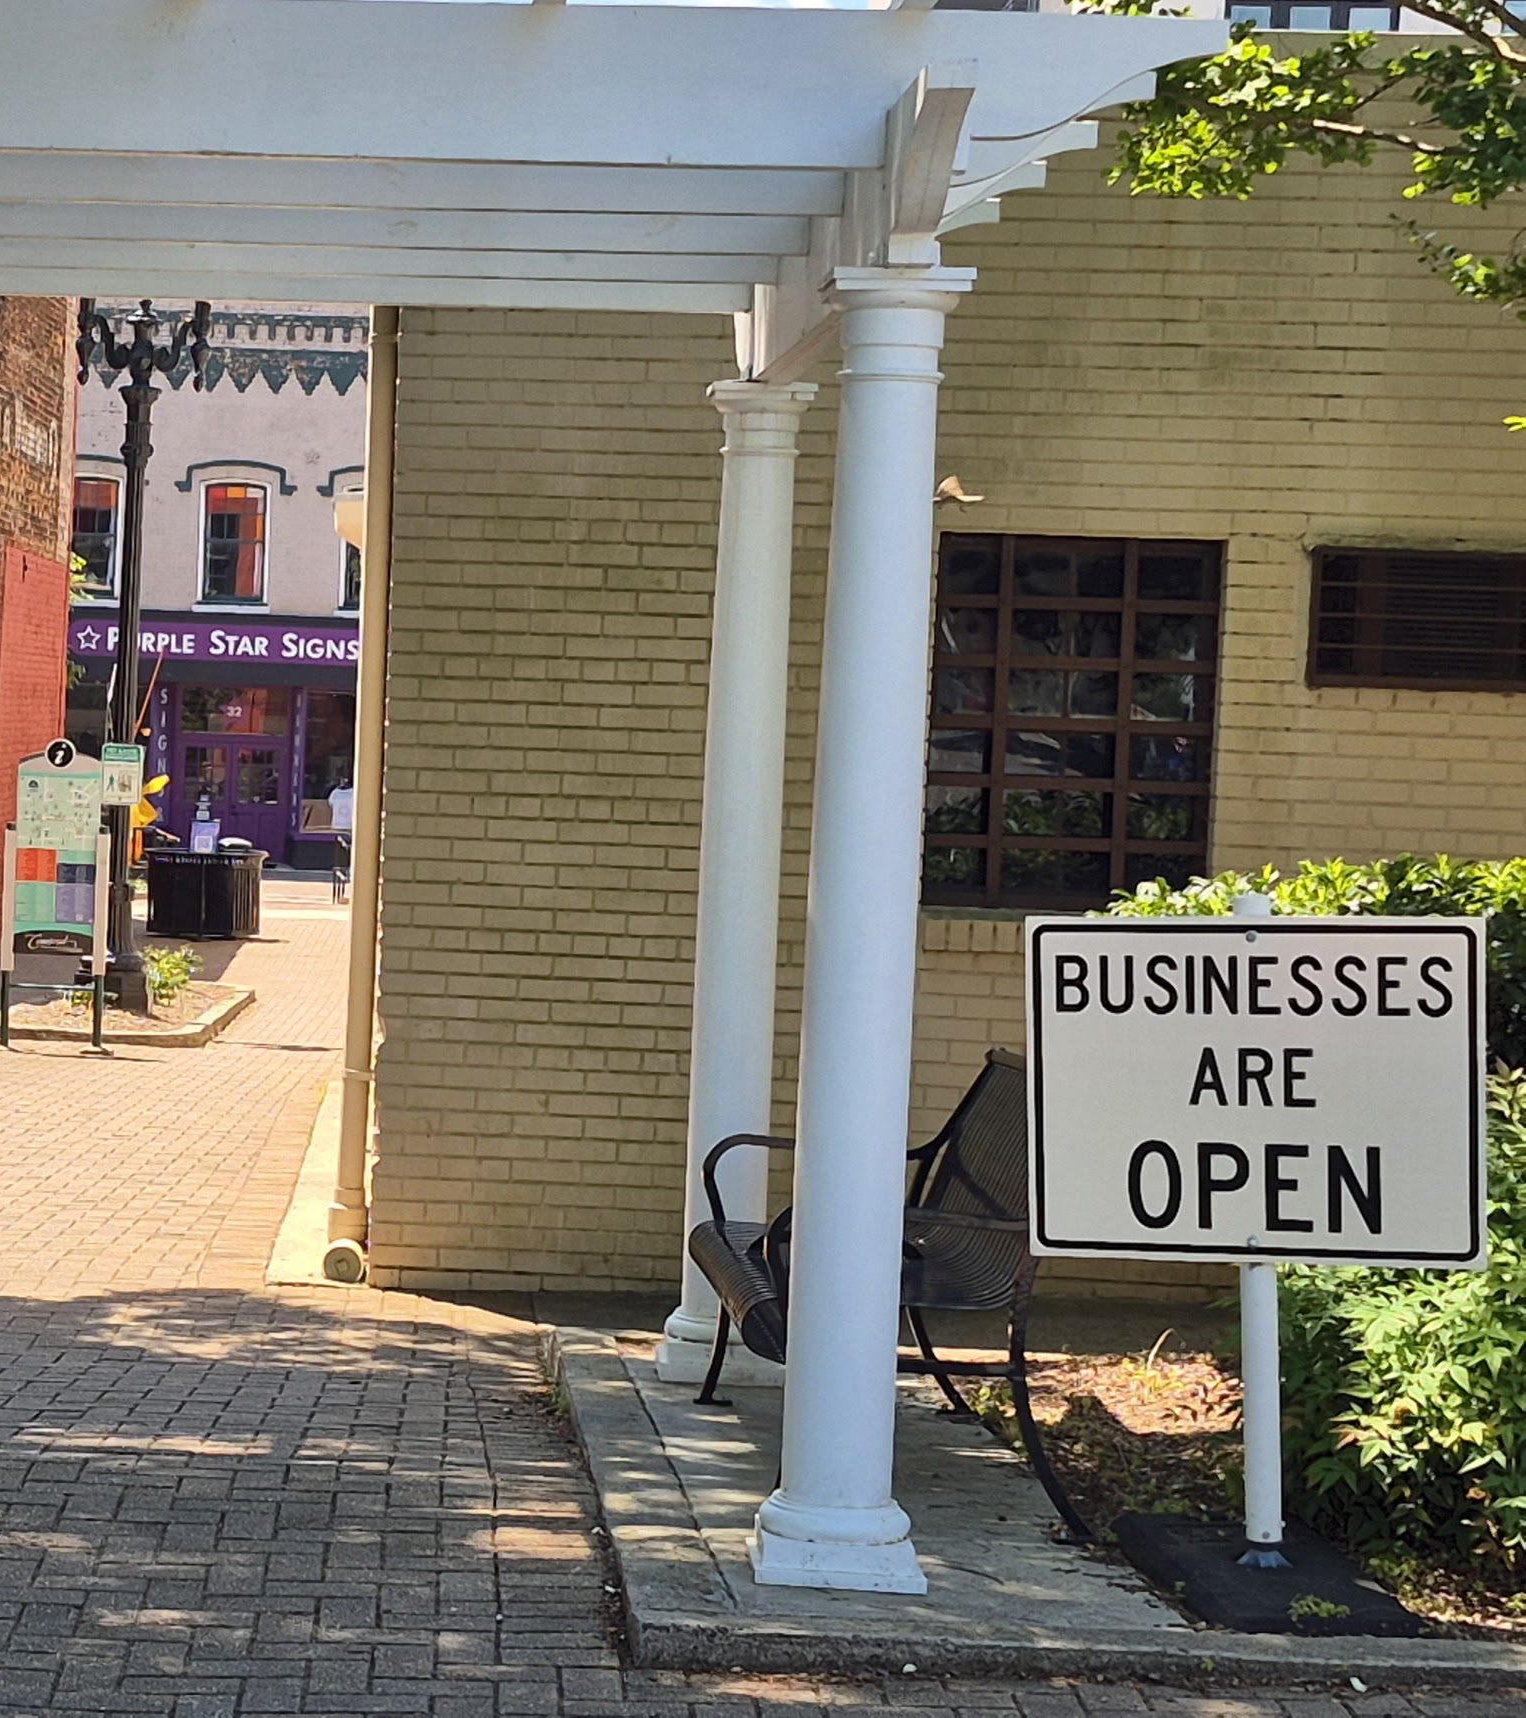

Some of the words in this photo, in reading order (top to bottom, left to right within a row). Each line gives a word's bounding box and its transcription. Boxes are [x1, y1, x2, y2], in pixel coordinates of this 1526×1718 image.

[106, 626, 196, 654] PRPLE
[209, 629, 269, 657] STAR
[281, 632, 359, 661] SIGNS
[226, 705, 242, 718] 32
[1055, 954, 1454, 1018] BUSINESSES
[1189, 1046, 1318, 1108] ARE
[1127, 1139, 1383, 1235] OPEN
